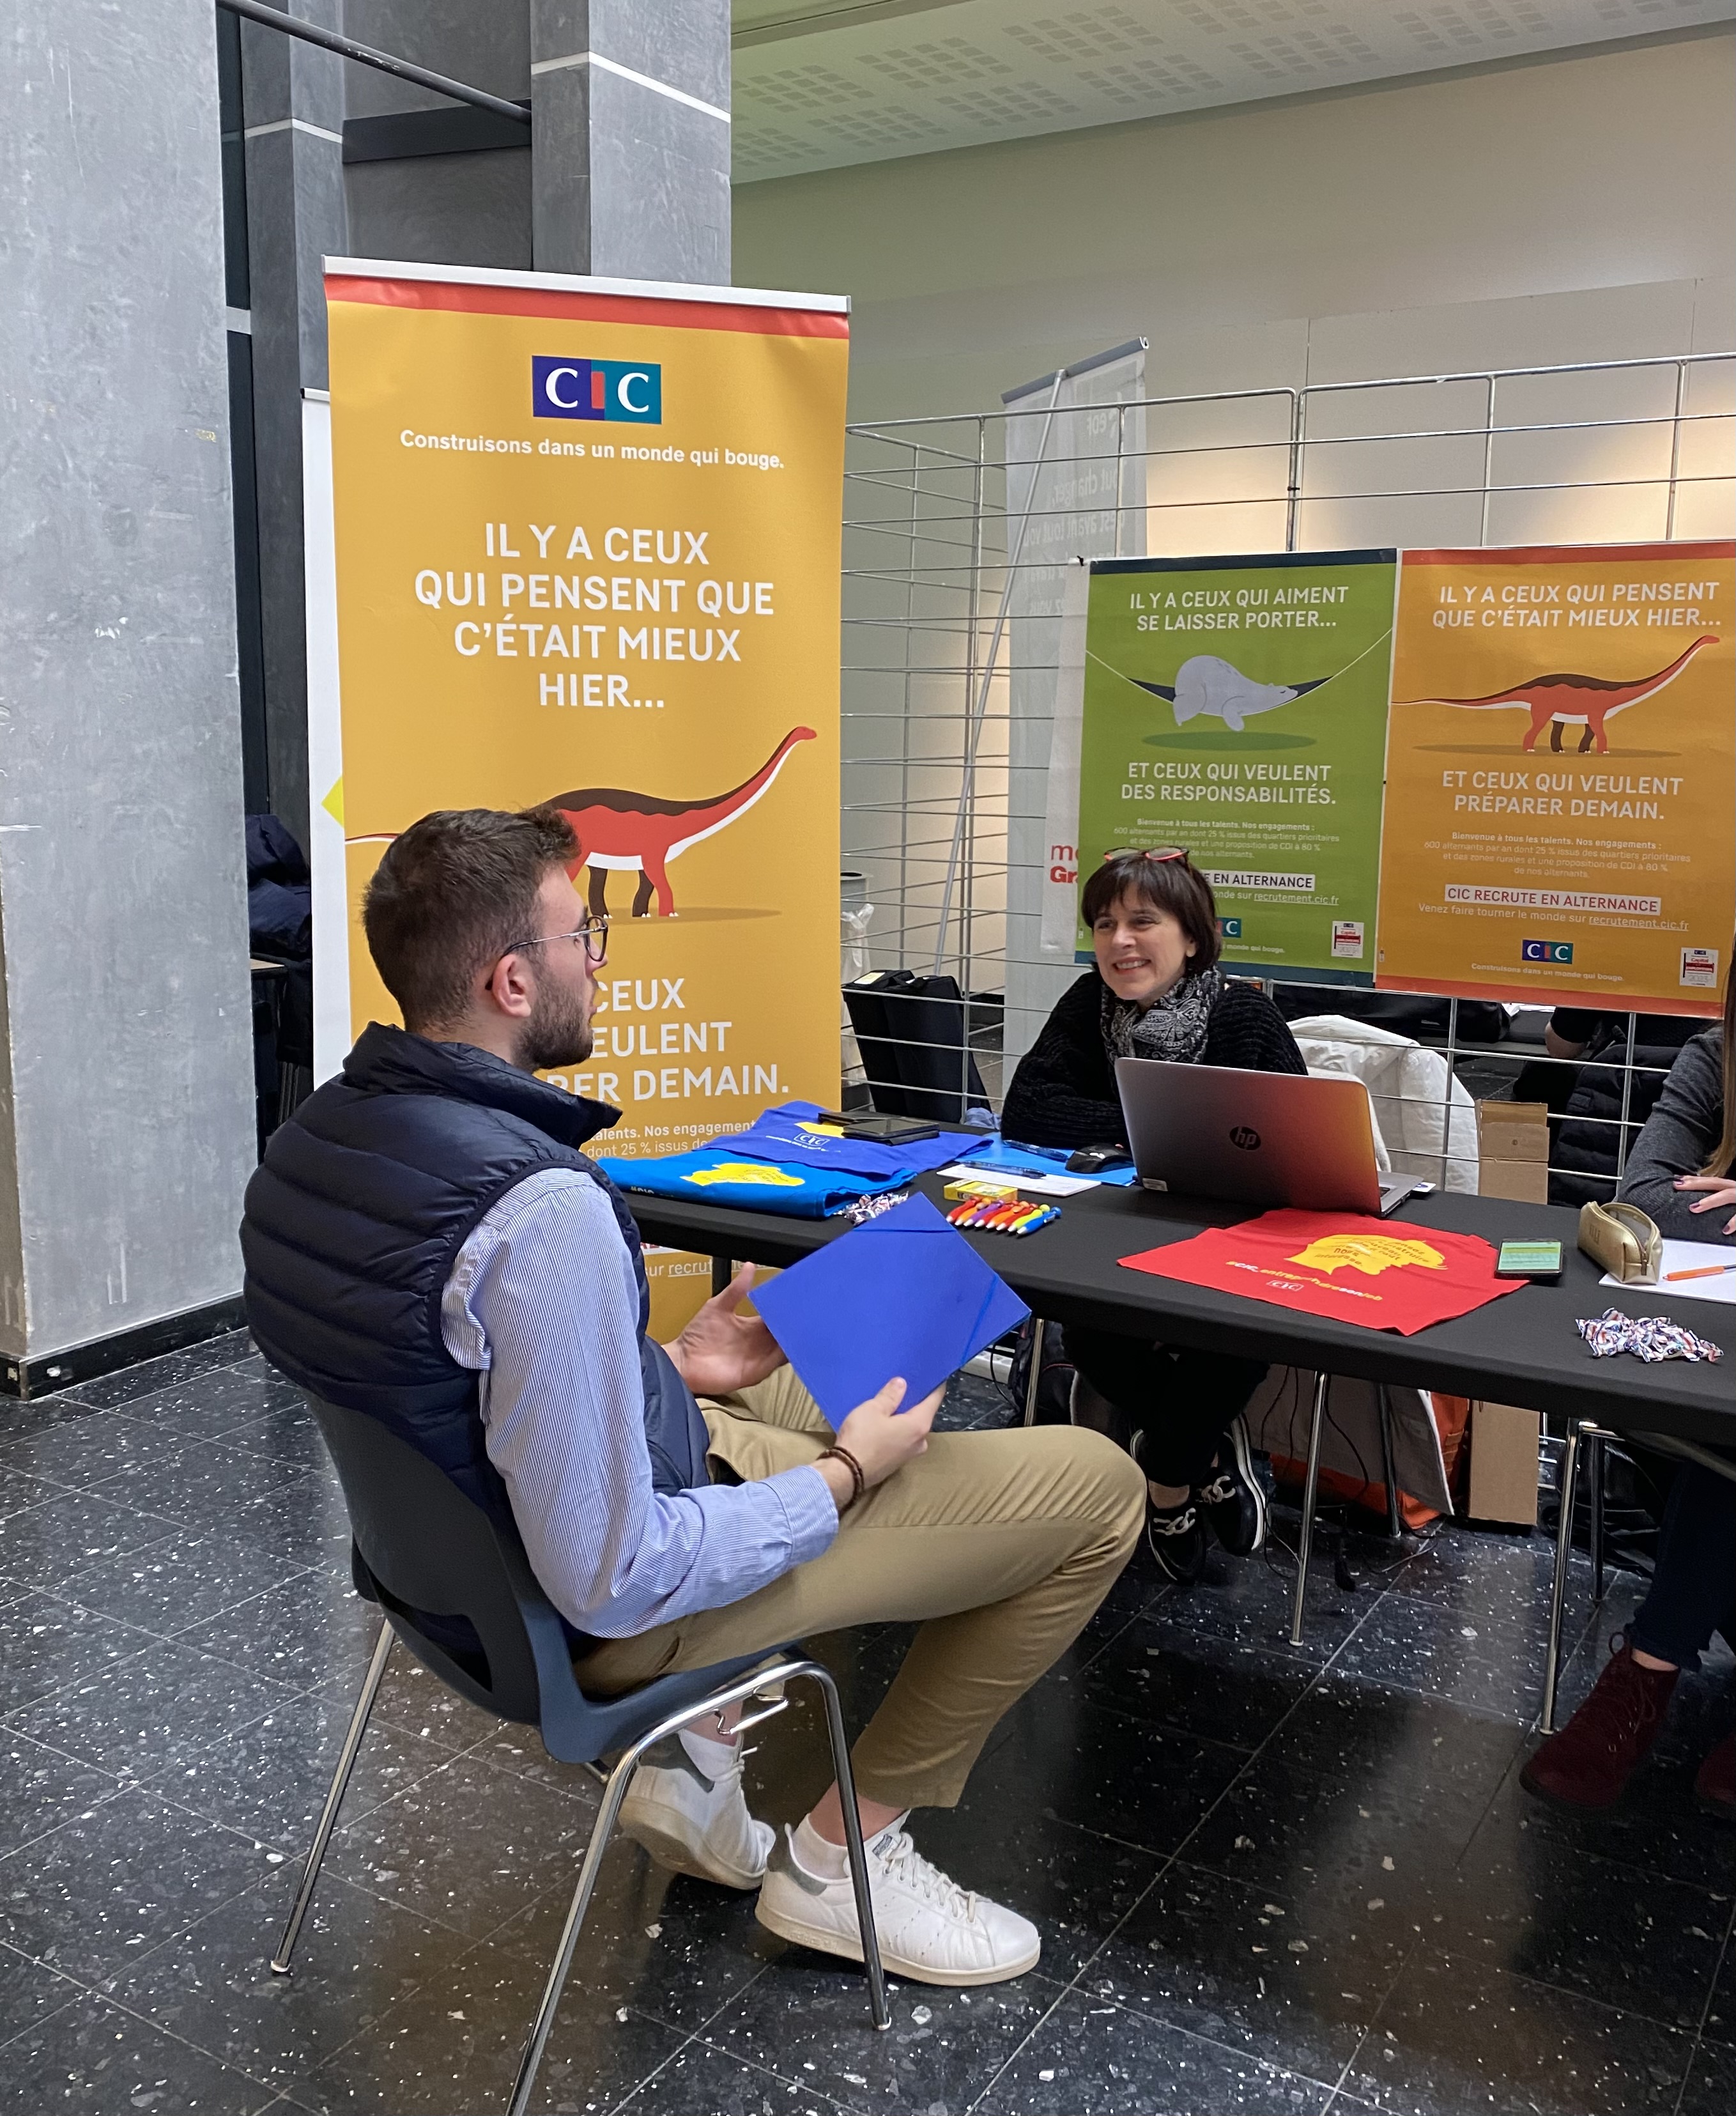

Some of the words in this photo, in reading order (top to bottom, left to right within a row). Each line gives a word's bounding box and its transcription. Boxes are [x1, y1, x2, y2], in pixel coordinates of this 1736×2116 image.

[545, 367, 649, 412] CIC
[400, 429, 532, 454] Construisons
[538, 438, 585, 457] dans
[592, 443, 615, 459] un
[620, 442, 685, 463] monde
[690, 447, 719, 468] qui
[724, 447, 785, 472] bouge.
[486, 523, 520, 558] IL
[528, 524, 557, 559] Y
[566, 527, 594, 560] A
[604, 526, 709, 565] CEUX
[415, 569, 485, 609] QUI
[502, 573, 686, 612] PENSENT
[696, 580, 774, 617] QUE
[1130, 593, 1145, 609] IL
[1149, 592, 1162, 608] Y
[1165, 592, 1177, 608] A
[1181, 591, 1231, 608] CEUX
[1236, 590, 1269, 608] QUI
[1273, 586, 1349, 605] AIMENT
[1440, 586, 1456, 603] IL
[1463, 585, 1476, 603] Y
[1480, 587, 1496, 603] A
[1502, 585, 1560, 603] CEUX
[1566, 584, 1605, 604] QUI
[1613, 581, 1720, 601] PENSENT
[1137, 615, 1158, 631] SE
[1165, 612, 1240, 631] LAISSER
[1245, 610, 1337, 629] PORTER...
[1432, 610, 1475, 628] QUE
[1568, 607, 1640, 627] MIEUX
[1647, 607, 1721, 626] HIER...
[618, 625, 741, 662] MIEUX
[539, 673, 664, 708] HIER...
[1128, 763, 1149, 778] ET
[1153, 763, 1202, 780] CEUX
[1206, 764, 1238, 781] QUI
[1244, 764, 1331, 782] VEULENT
[1442, 771, 1468, 788] ET
[1473, 772, 1529, 791] CEUX
[1535, 773, 1572, 792] QUI
[1579, 775, 1684, 795] VEULENT
[1121, 784, 1155, 801] DES
[1160, 783, 1337, 805] RESPONSABILITÉS.
[1454, 791, 1563, 815] PRÉPARER
[1570, 799, 1664, 820] DEMAIN.
[1137, 818, 1174, 827] Bienvenue
[1212, 821, 1240, 829] talents.
[1258, 823, 1310, 831] engagements
[1225, 841, 1266, 850] proposition
[1263, 833, 1296, 842] quartiers
[1298, 834, 1339, 843] prioritaires
[1452, 832, 1495, 841] Bienvenue
[1497, 833, 1502, 842] à
[1526, 835, 1538, 843] les
[1540, 835, 1574, 845] talents.
[1595, 840, 1657, 849] engagements
[1496, 855, 1525, 863] rurales
[1556, 859, 1604, 869] proposition
[1514, 844, 1534, 853] dont
[1558, 848, 1580, 856] issus
[1582, 849, 1598, 857] des
[1600, 850, 1640, 860] quartiers
[1642, 853, 1691, 863] prioritaires
[1050, 866, 1077, 883] Gr
[1214, 874, 1229, 884] EN
[1232, 873, 1313, 888] ALTERNANCE
[1514, 866, 1525, 874] de
[1544, 868, 1590, 878] alternants.
[1214, 890, 1235, 899] onde
[1254, 892, 1340, 906] recrutement.cic.fr
[1448, 888, 1470, 899] CIC
[1474, 890, 1537, 904] RECRUTE
[1541, 894, 1559, 906] EN
[1563, 895, 1658, 912] ALTERNANCE
[1418, 902, 1448, 914] Venez
[1451, 905, 1474, 915] faire
[1477, 907, 1516, 918] tourner
[1518, 910, 1527, 918] le
[1530, 911, 1566, 922] monde
[1569, 915, 1586, 923] sur
[1589, 915, 1689, 932] recrutement.cic.fr
[1526, 943, 1569, 960] CIC
[1471, 963, 1521, 973] Construisons
[590, 1021, 733, 1058] EULENT
[634, 1063, 789, 1100] DEMAIN.
[645, 1124, 670, 1138] Nos
[1234, 1125, 1257, 1149] hp
[587, 1145, 617, 1158] dont
[620, 1143, 637, 1155] 25
[640, 1141, 652, 1154] %
[655, 1138, 688, 1152] issus
[692, 1136, 709, 1150] de
